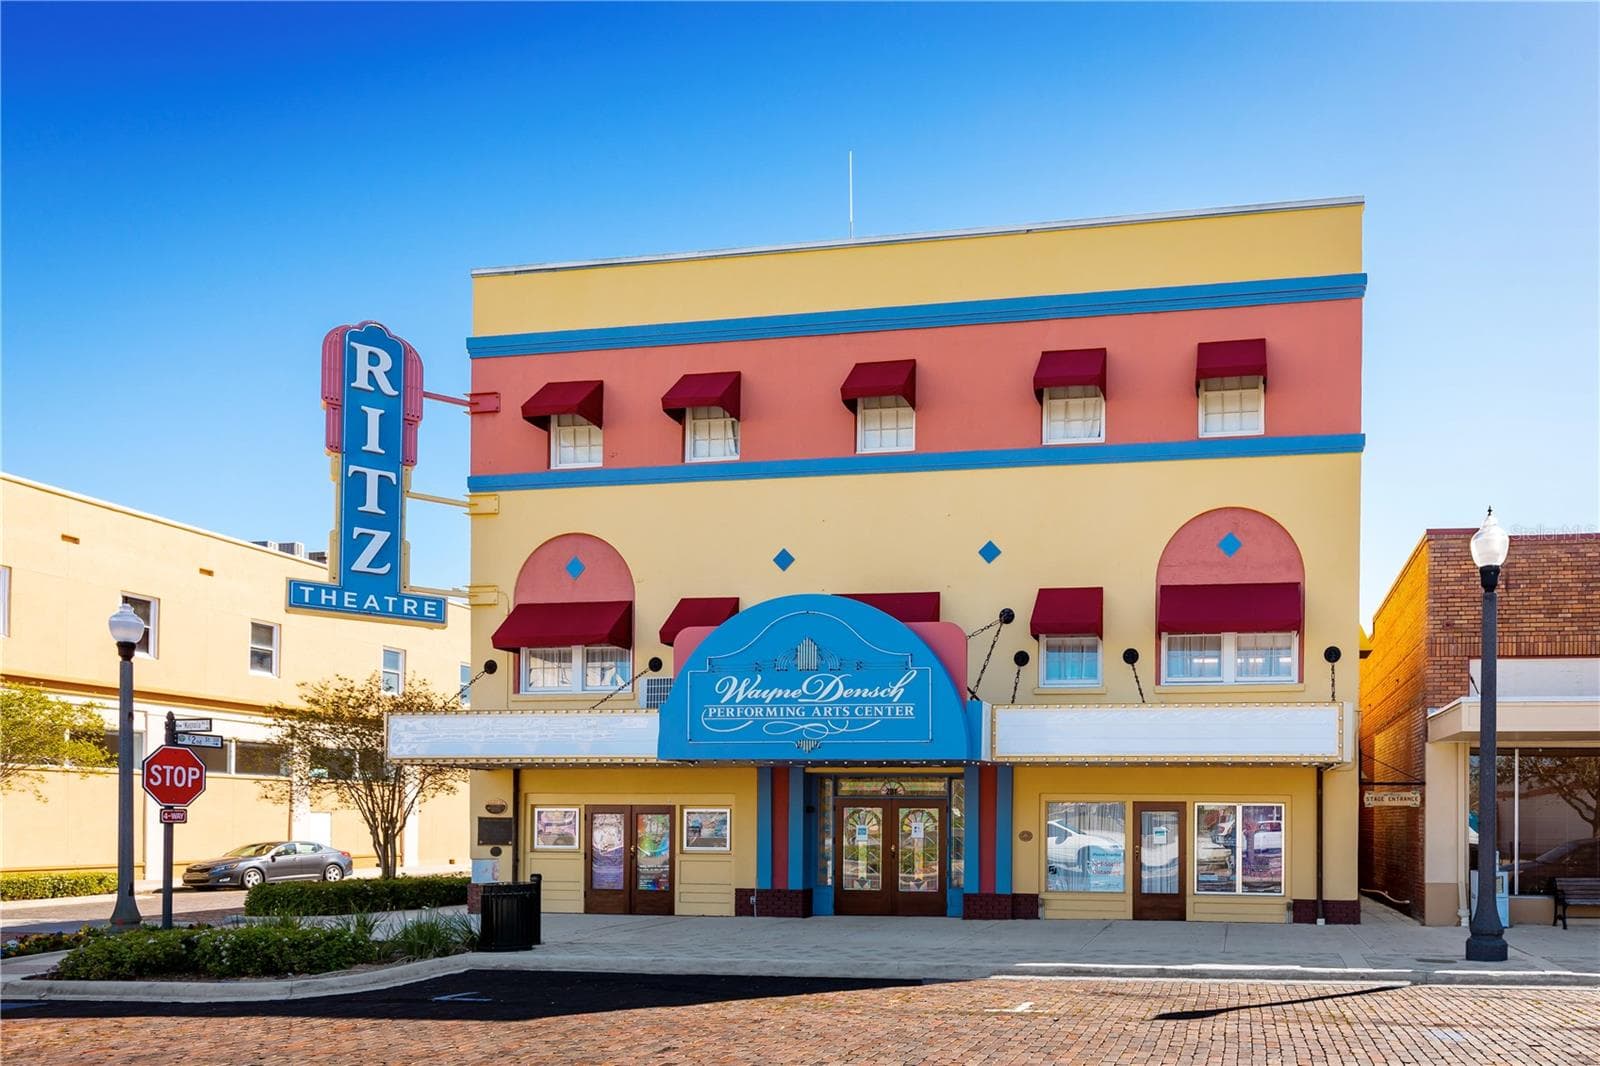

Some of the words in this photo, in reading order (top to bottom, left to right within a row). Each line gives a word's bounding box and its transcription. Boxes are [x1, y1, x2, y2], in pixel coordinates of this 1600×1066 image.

[348, 341, 399, 575] RITZ
[299, 586, 437, 617] THEATRE
[715, 674, 802, 704] Wayne
[798, 669, 917, 704] Densch
[708, 706, 806, 718] PERFORMING
[812, 705, 850, 717] ARTS
[854, 705, 914, 717] CENTER
[149, 764, 200, 788] STOP
[163, 812, 184, 820] 4-WAY
